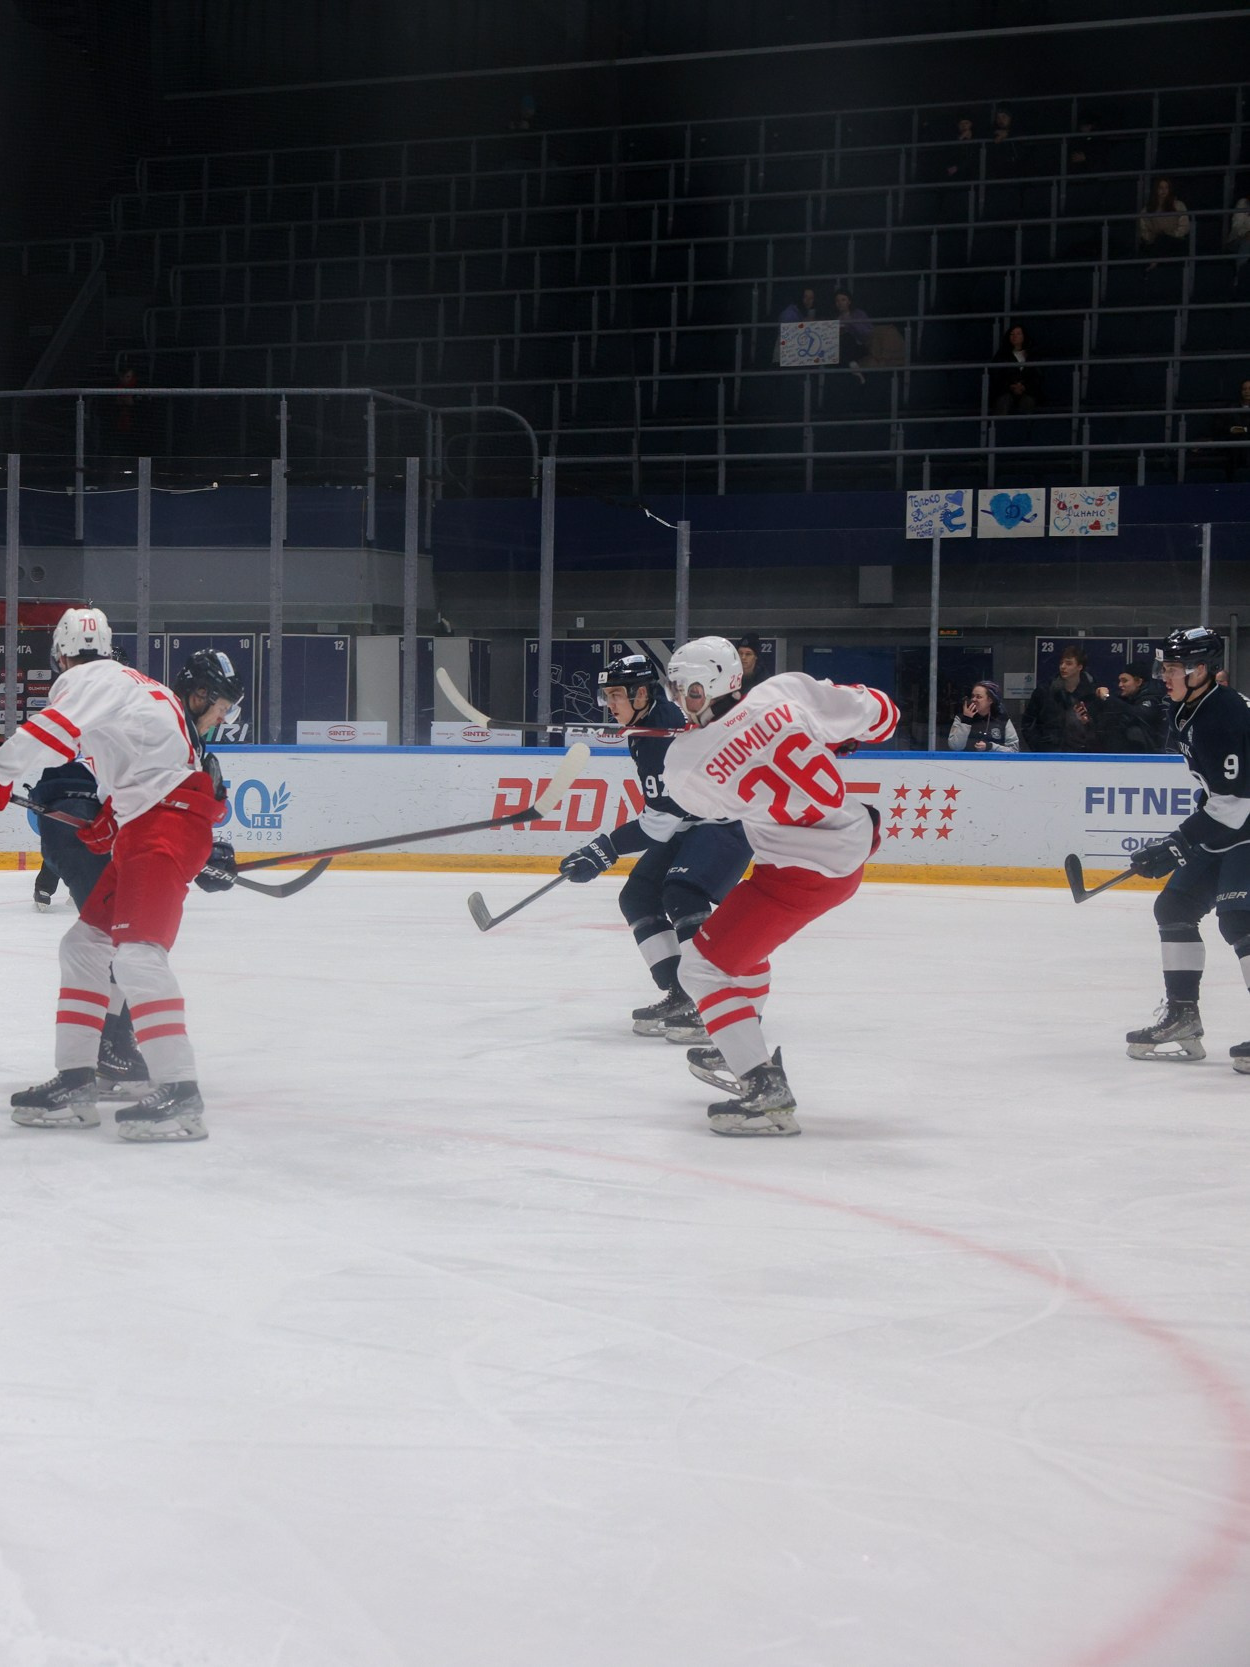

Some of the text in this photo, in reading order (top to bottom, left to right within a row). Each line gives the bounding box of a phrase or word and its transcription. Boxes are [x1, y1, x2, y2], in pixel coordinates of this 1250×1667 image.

[79, 619, 97, 632] 70
[154, 639, 161, 649] 8
[173, 639, 180, 649] 9
[239, 639, 250, 649] 10
[334, 641, 344, 651] 12
[530, 644, 538, 654] 17
[591, 644, 602, 654] 18
[612, 644, 623, 654] 19
[762, 643, 773, 653] 22
[1041, 642, 1054, 653] 23
[1111, 643, 1123, 653] 24
[1136, 643, 1150, 653] 25
[705, 704, 794, 785] SHUMILOV
[1223, 754, 1239, 780] 9
[737, 732, 846, 828] 26
[252, 815, 280, 828] ЛЕТ
[217, 831, 282, 842] 73-2023
